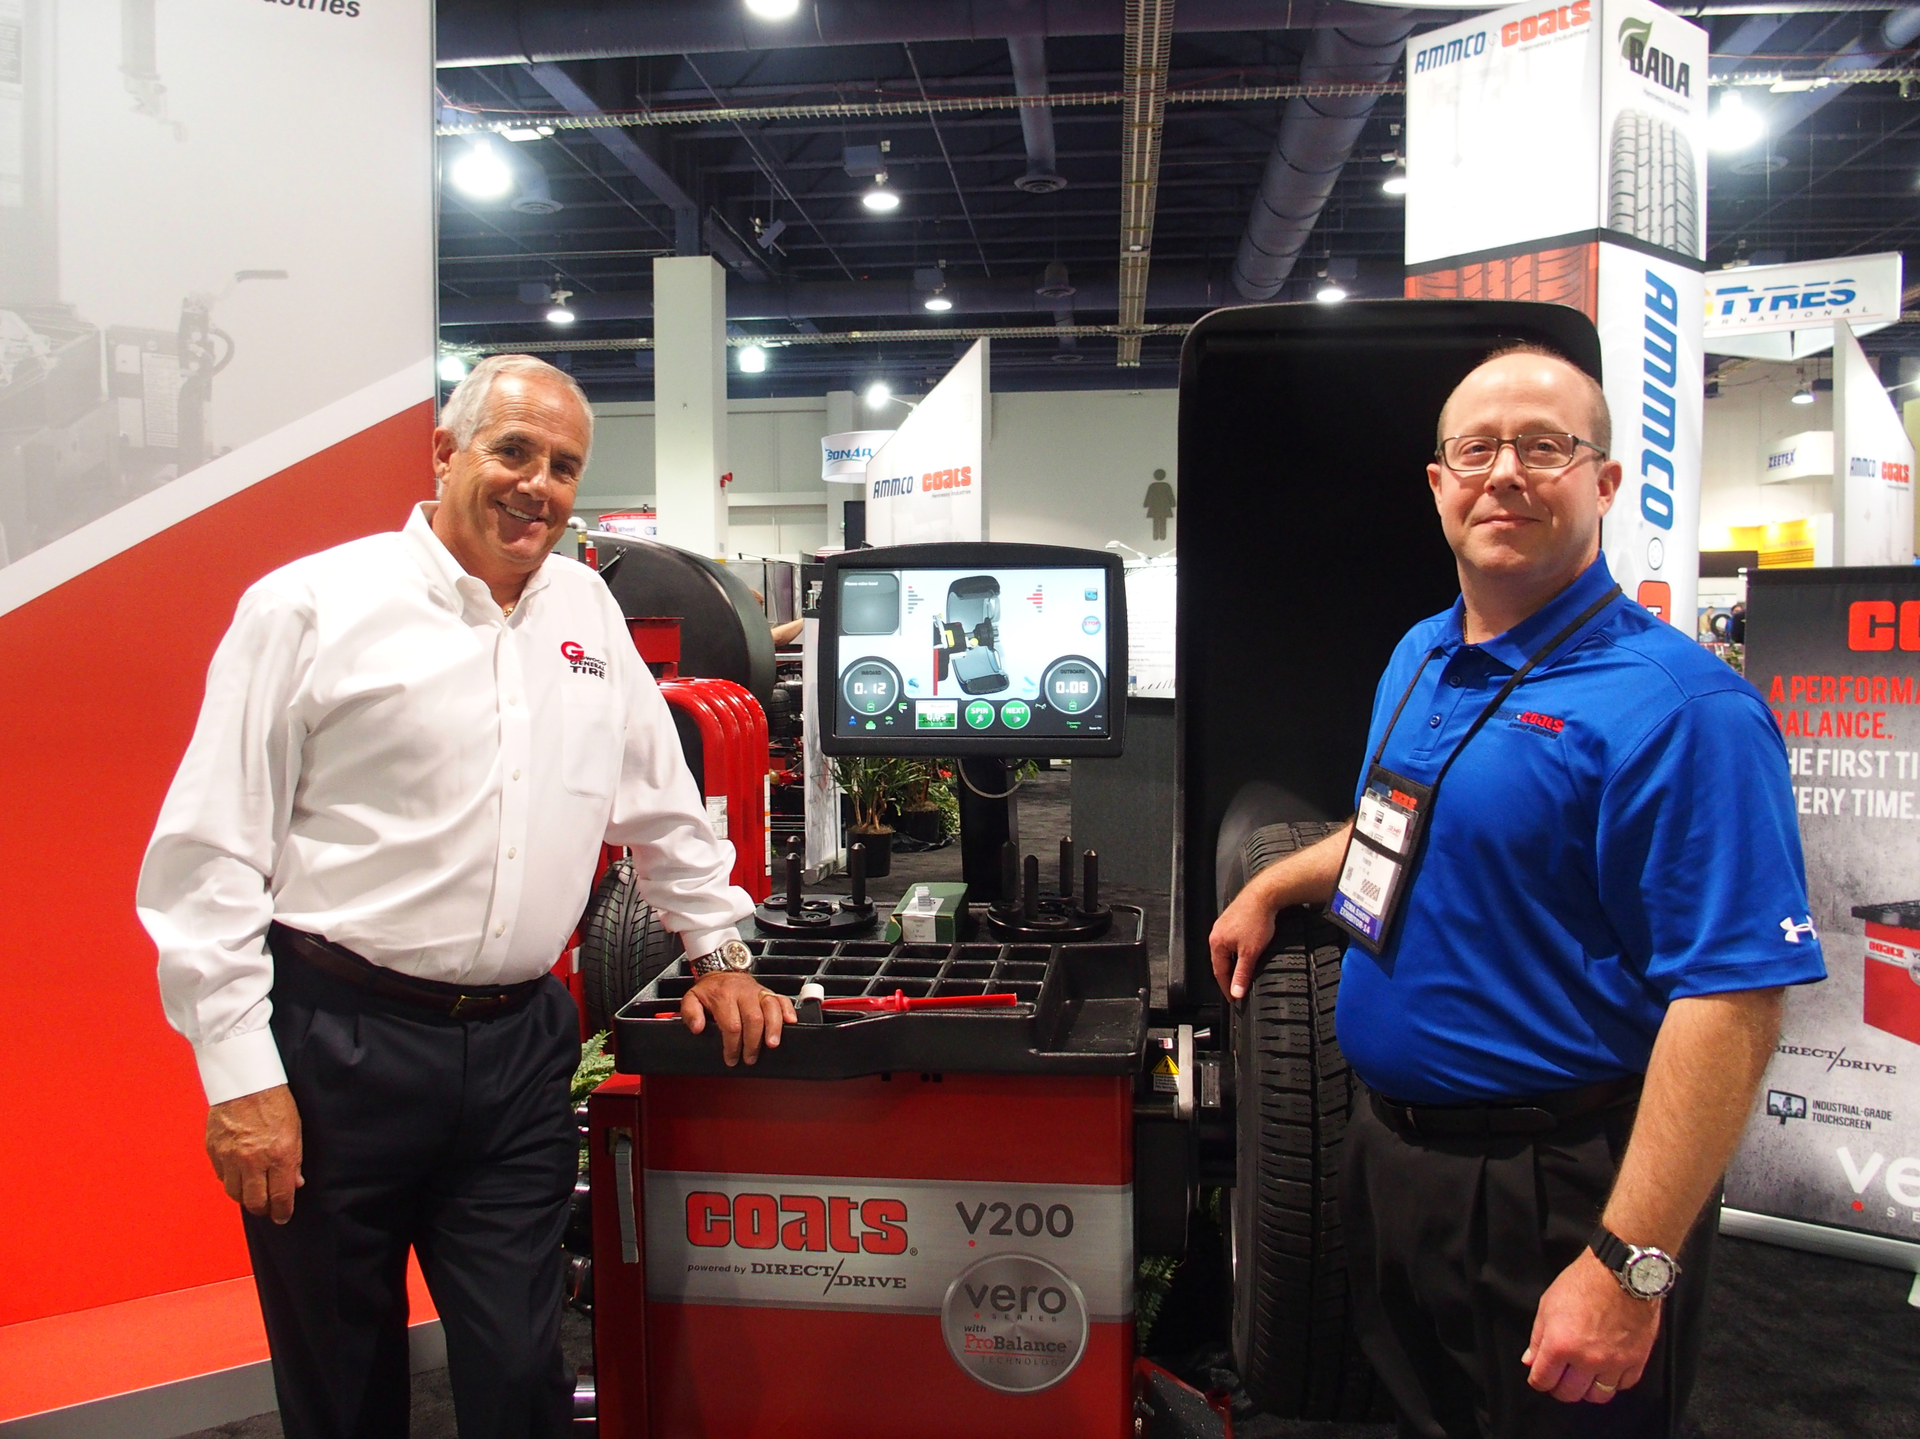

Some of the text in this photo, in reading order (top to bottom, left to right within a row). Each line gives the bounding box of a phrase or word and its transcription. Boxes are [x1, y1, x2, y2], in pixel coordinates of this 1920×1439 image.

[1414, 31, 1486, 74] AMMCO
[1629, 35, 1690, 98] BADA
[1641, 269, 1678, 531] AMMCO
[873, 476, 914, 500] AMMCO
[569, 665, 605, 680] TIRE
[854, 682, 887, 695] 0.12
[1055, 681, 1089, 694] 0.08
[1769, 675, 1785, 703] A
[970, 707, 989, 715] SPIN
[1005, 707, 1026, 715] NEXT
[1817, 748, 1890, 779] FIRST
[1812, 1099, 1893, 1121] INDUSTRIAL-GRADE
[1812, 1111, 1873, 1131] TOUCHSCREEN
[955, 1201, 1075, 1239] V200
[687, 1264, 732, 1274] powered
[734, 1265, 747, 1275] by
[964, 1283, 1068, 1315] vero
[991, 1313, 1058, 1323] SERIES
[964, 1324, 987, 1333] with
[964, 1334, 1068, 1353] ProBalance
[981, 1355, 1067, 1367] TECHNOLOGY
